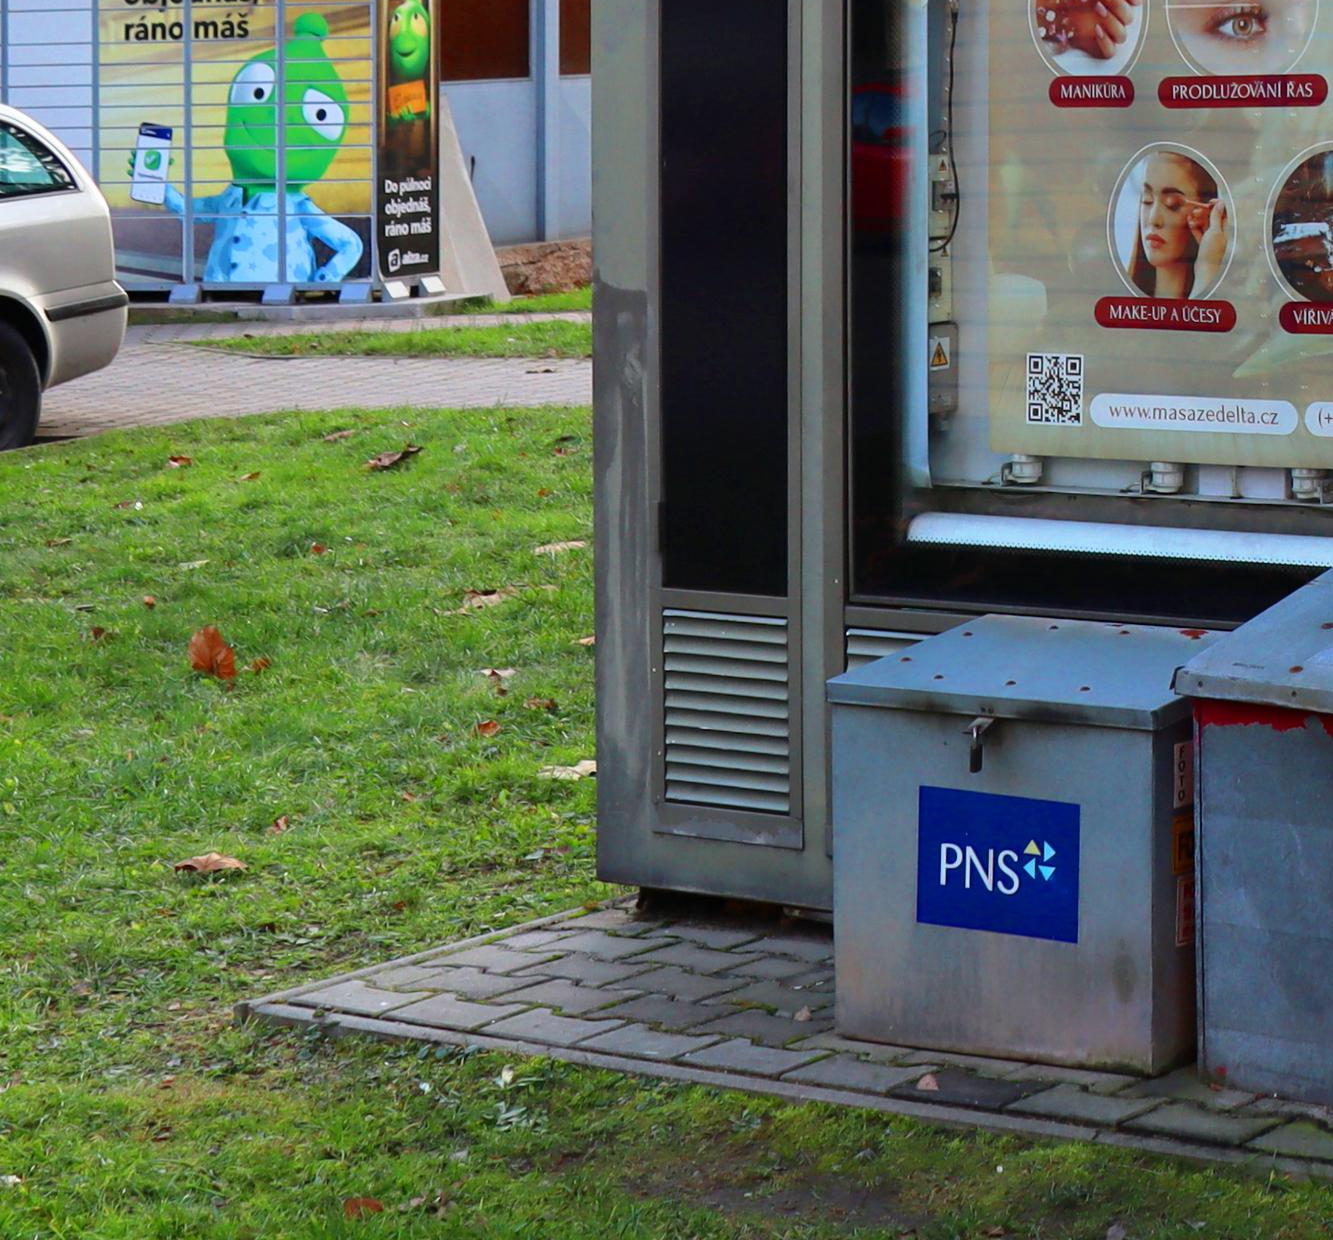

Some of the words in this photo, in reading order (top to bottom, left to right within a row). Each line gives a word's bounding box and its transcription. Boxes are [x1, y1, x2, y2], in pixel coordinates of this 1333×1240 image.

[124, 15, 184, 41] ráno
[193, 12, 249, 39] máš
[1172, 81, 1282, 100] PRODLUŽOVÁNÍ
[1286, 80, 1313, 99] ŘAS
[384, 179, 399, 194] Do
[399, 176, 432, 197] půlnoci
[384, 220, 410, 237] ráno
[410, 217, 432, 234] máš
[1109, 304, 1167, 322] MAKE-UP
[1170, 307, 1180, 321] A
[1182, 304, 1222, 324] ÚČESY
[1108, 404, 1280, 426] www.masazedelta.cz
[939, 842, 1020, 895] PNS
